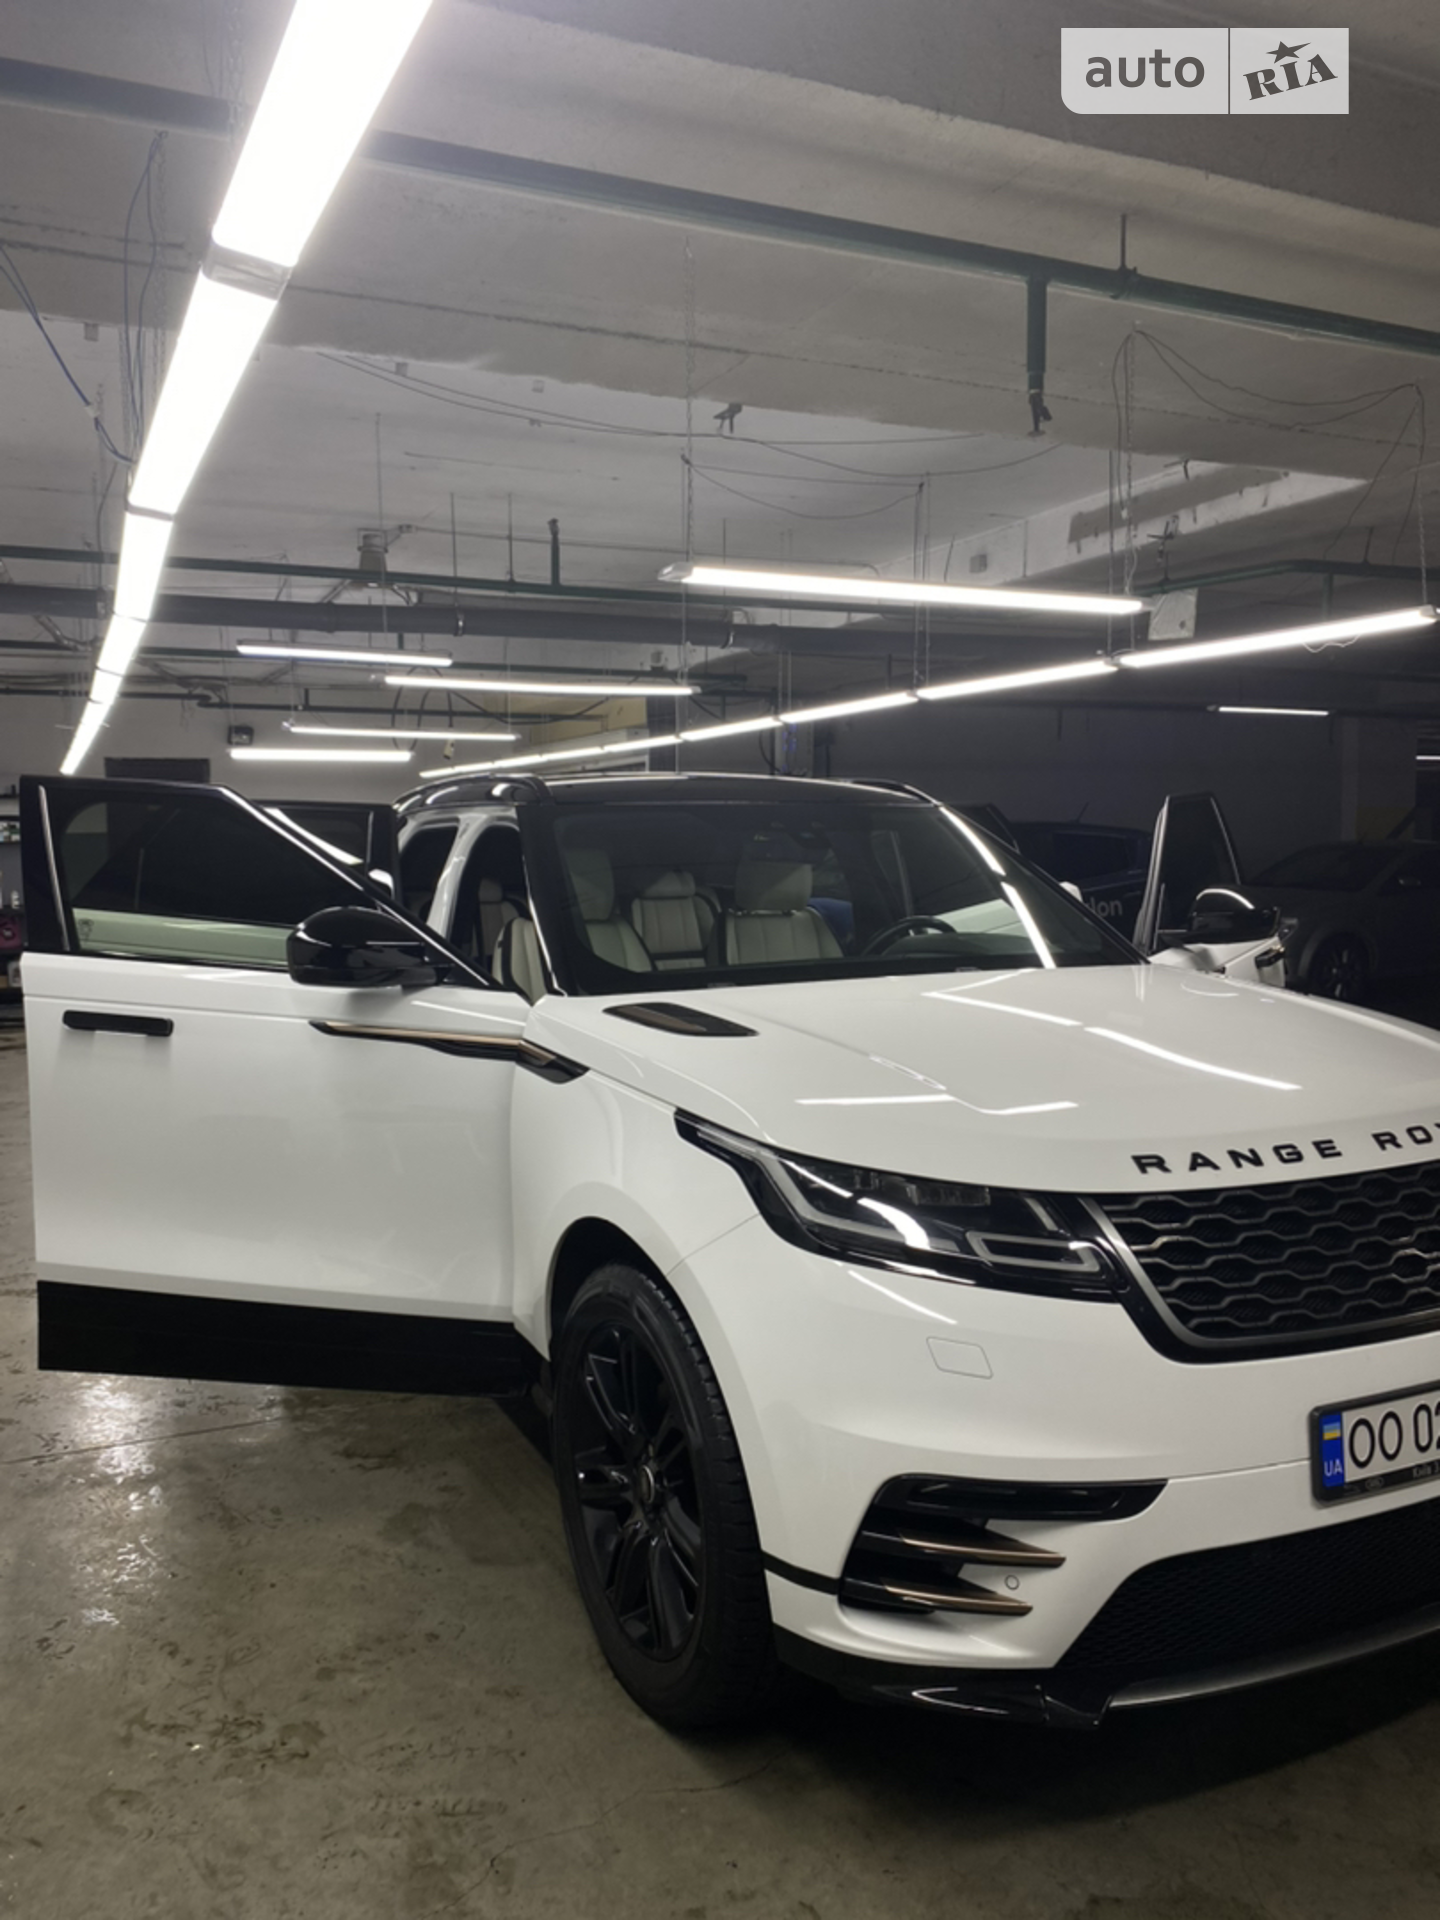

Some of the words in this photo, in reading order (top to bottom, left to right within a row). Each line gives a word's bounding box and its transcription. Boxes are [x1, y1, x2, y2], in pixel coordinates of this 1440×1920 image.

[1131, 1139, 1343, 1175] RANGE
[1371, 1123, 1440, 1151] RO
[1323, 1459, 1343, 1477] UA
